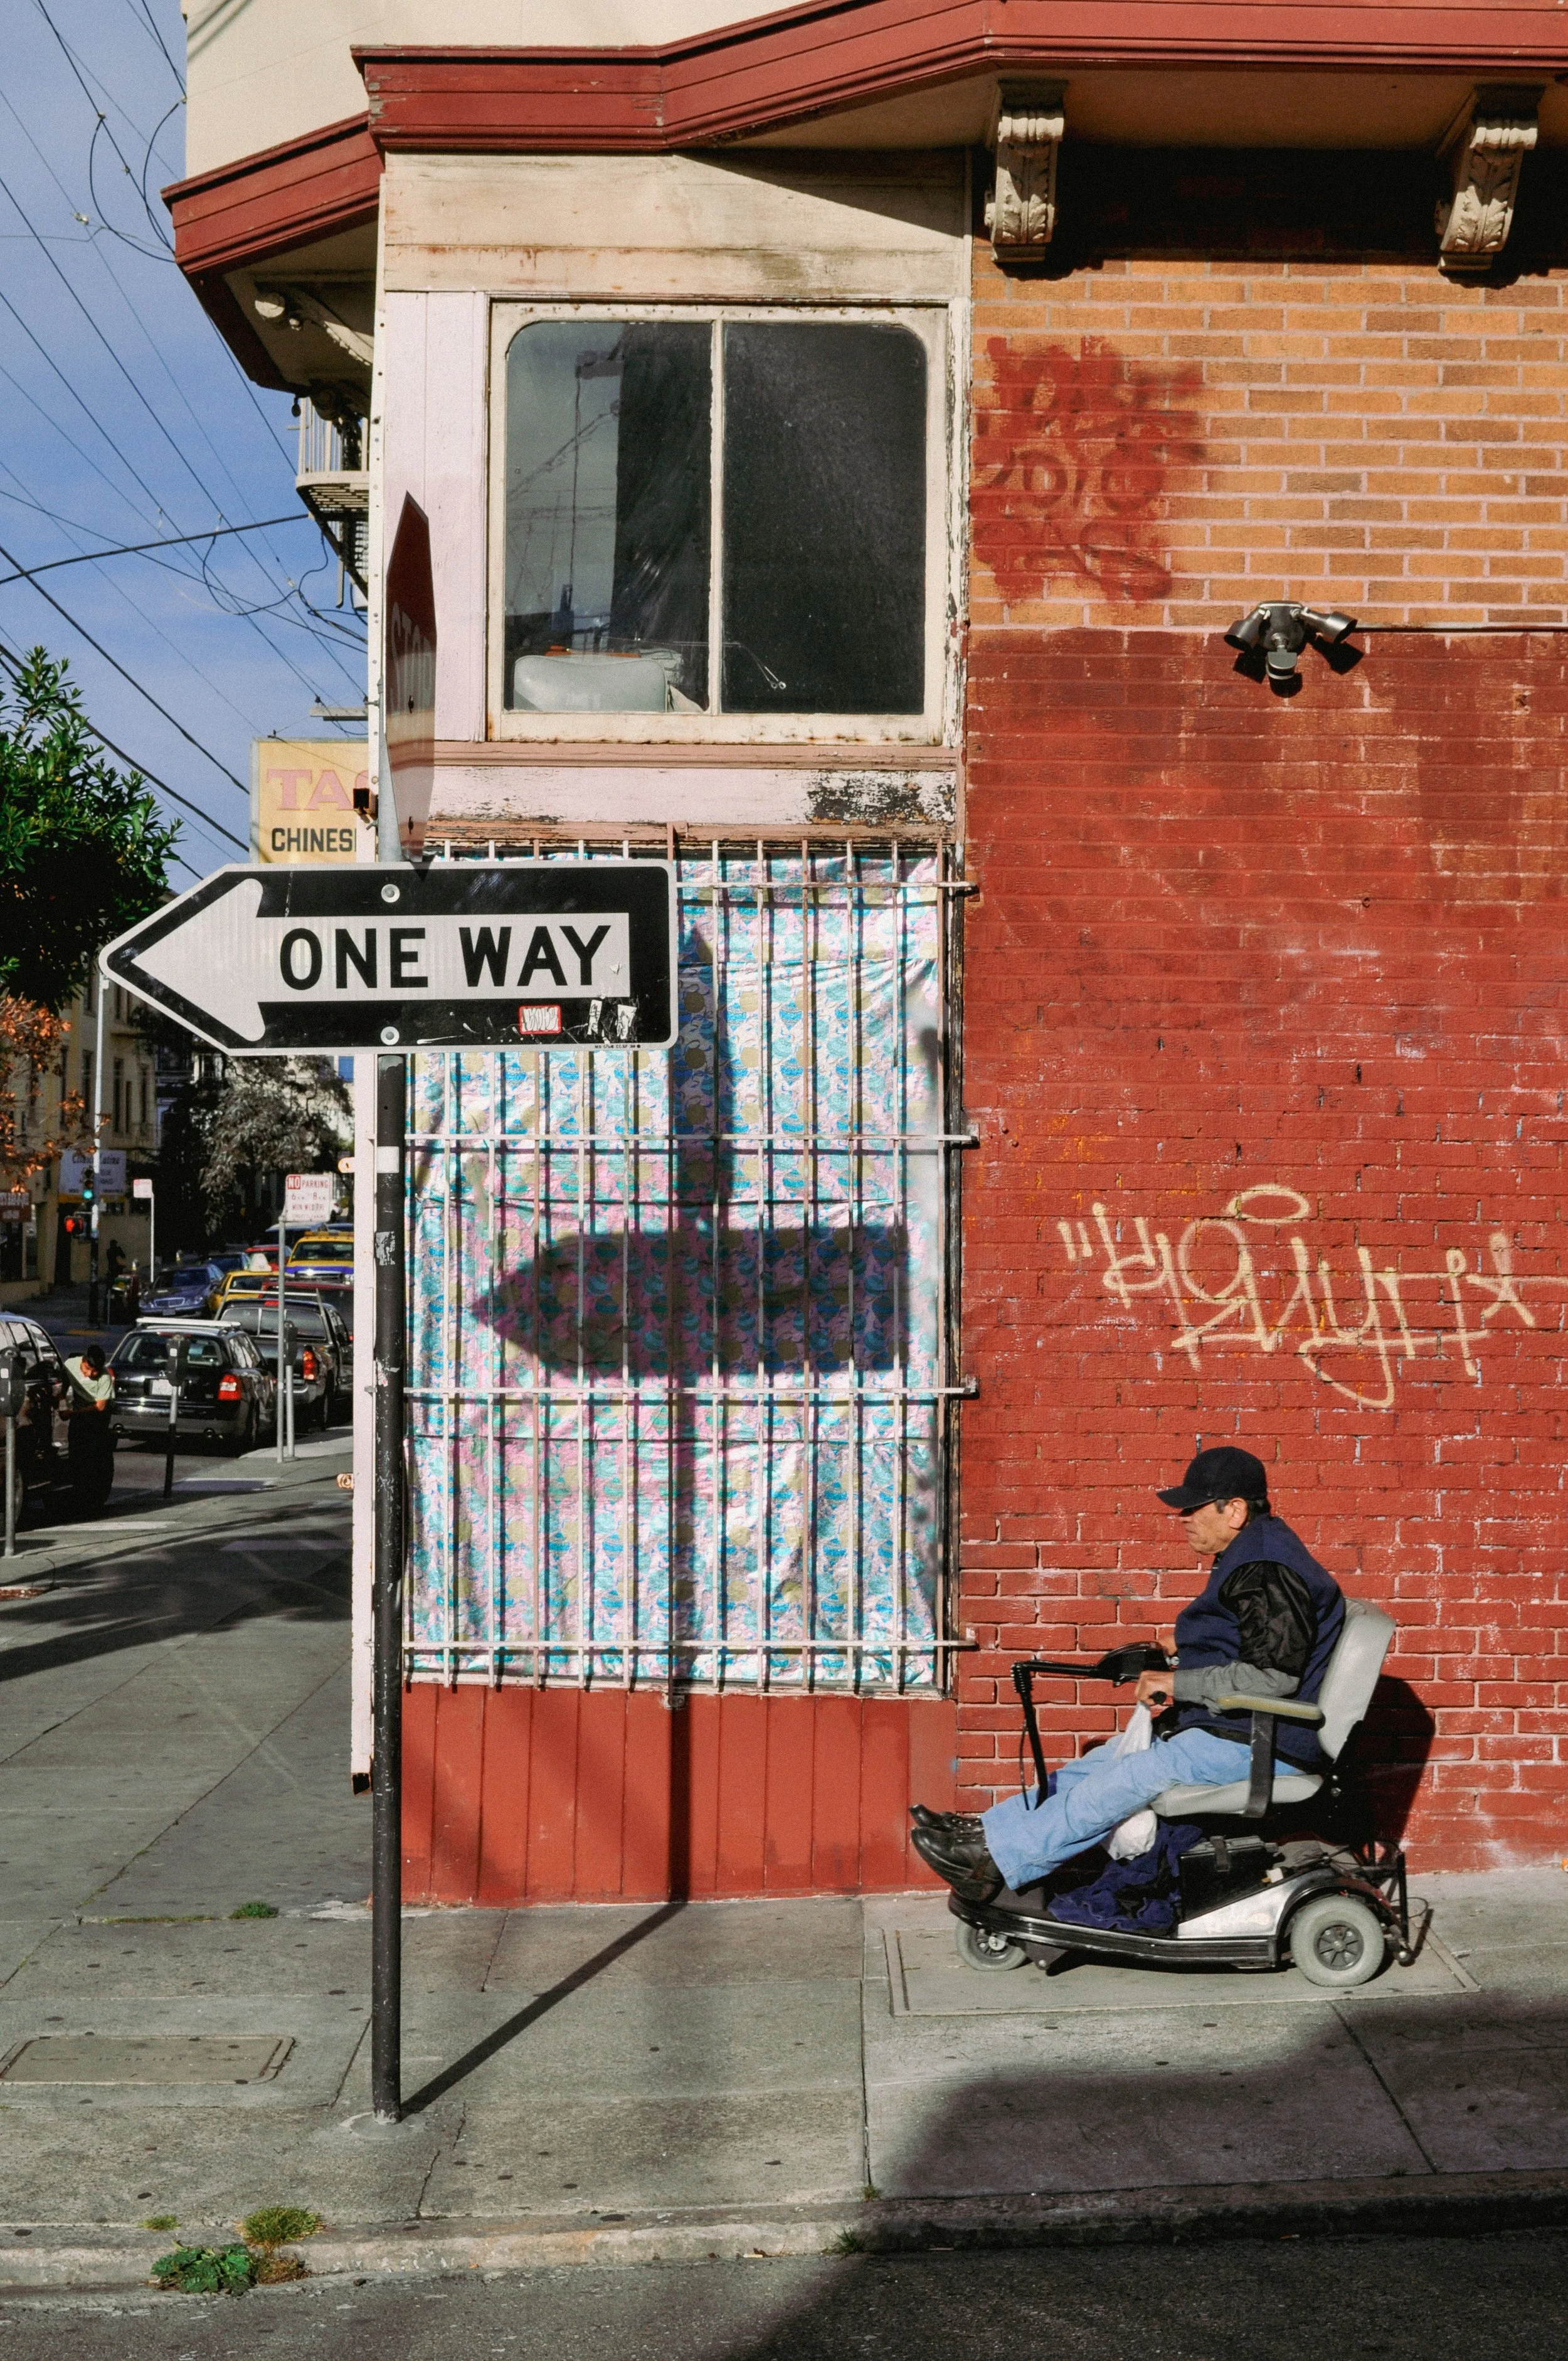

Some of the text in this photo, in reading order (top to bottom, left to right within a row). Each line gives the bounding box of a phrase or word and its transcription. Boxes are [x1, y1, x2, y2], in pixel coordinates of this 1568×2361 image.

[272, 827, 356, 852] CHINES
[280, 925, 612, 990] ONE WAY
[289, 1176, 329, 1189] NO PARKING
